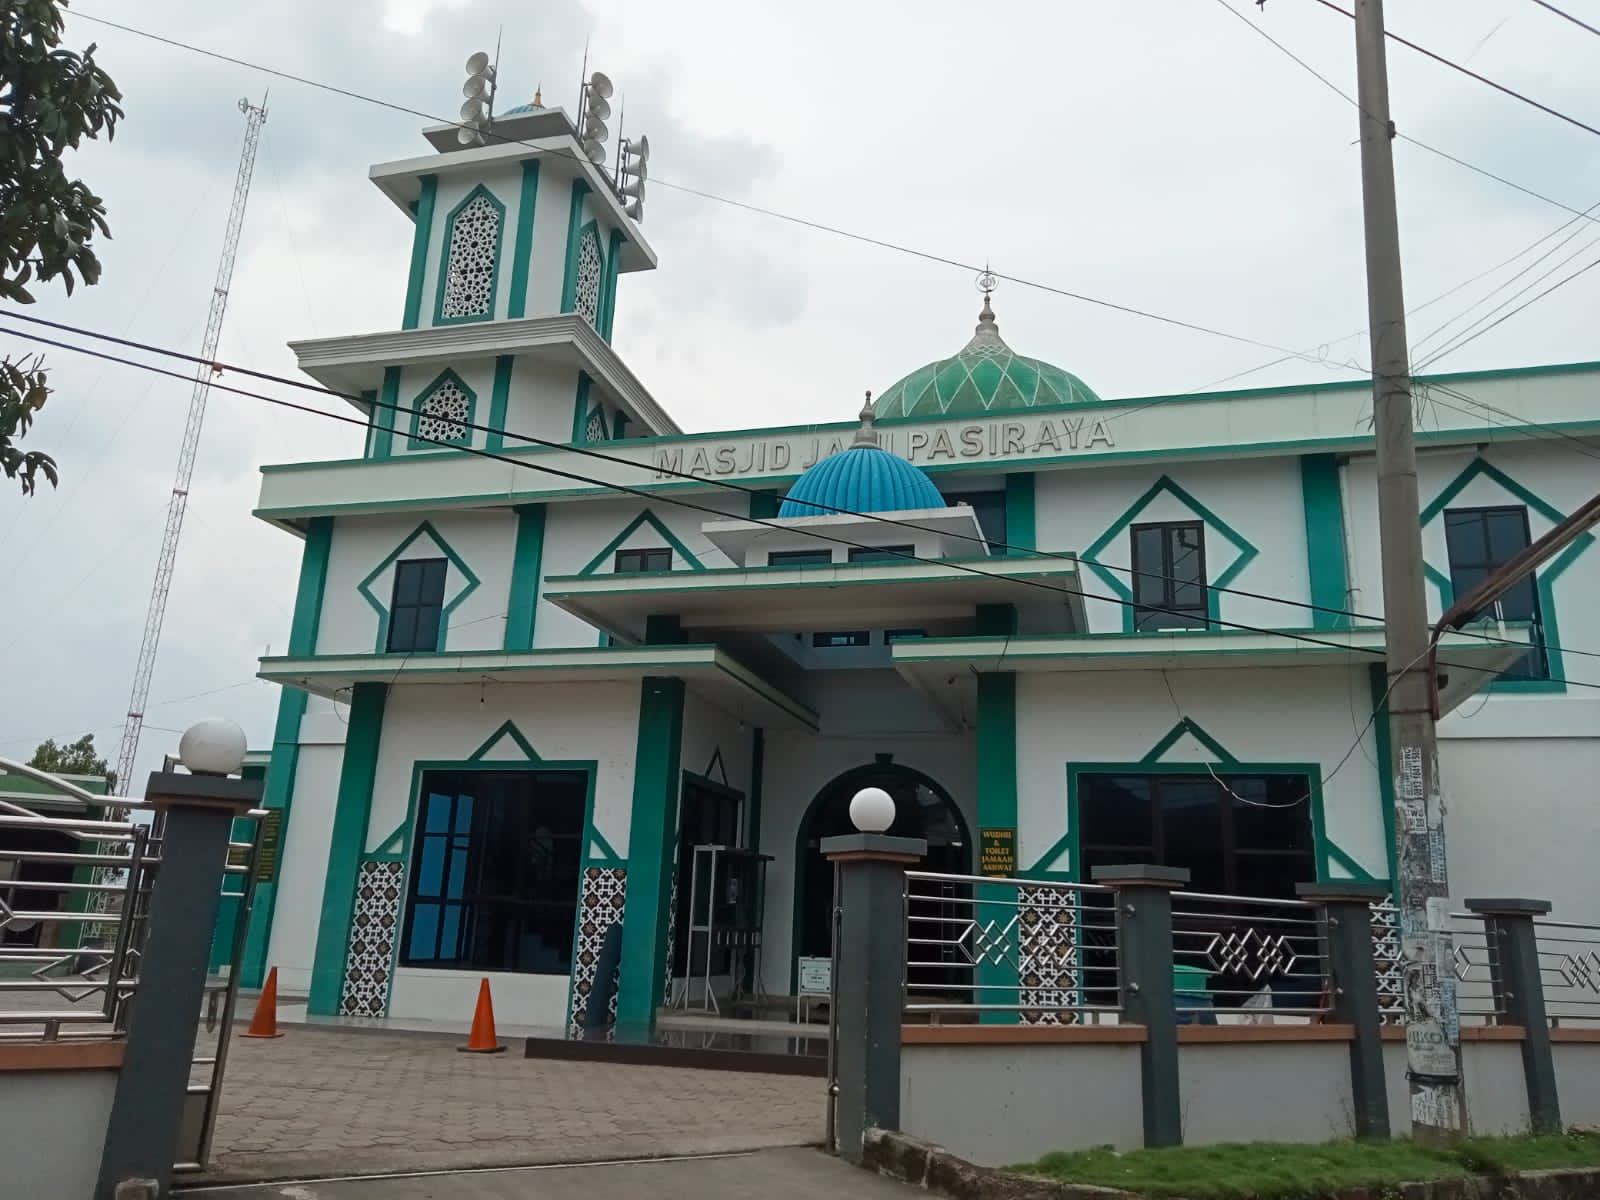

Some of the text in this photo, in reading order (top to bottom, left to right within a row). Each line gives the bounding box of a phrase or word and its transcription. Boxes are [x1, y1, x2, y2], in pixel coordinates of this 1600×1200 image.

[655, 440, 792, 479] MASJID
[907, 415, 1115, 462] PASIRAYA
[985, 847, 1009, 855] TOILET
